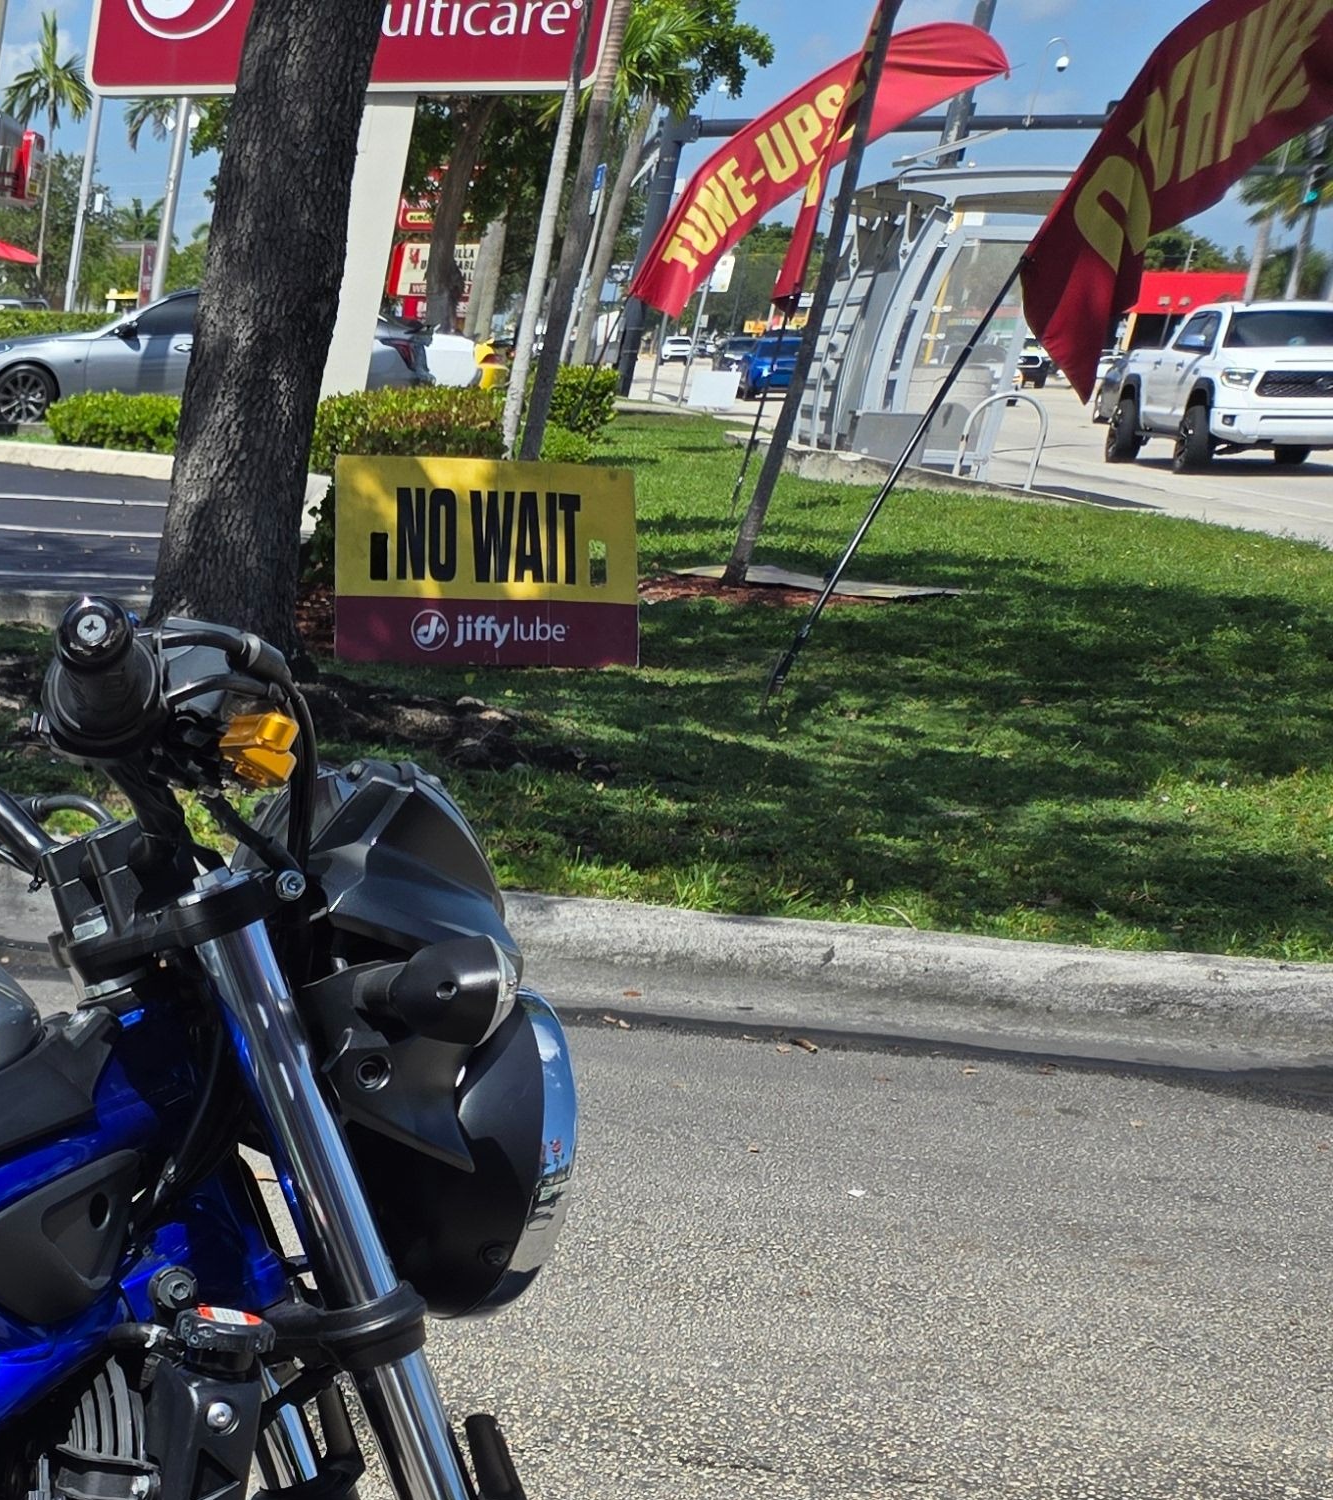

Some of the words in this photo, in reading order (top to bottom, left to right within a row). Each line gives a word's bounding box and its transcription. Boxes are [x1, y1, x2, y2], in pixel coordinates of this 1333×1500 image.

[381, 0, 572, 37] ulticare
[661, 84, 847, 273] TUNE-UPS
[396, 487, 458, 582] NO
[469, 490, 581, 585] WAIT
